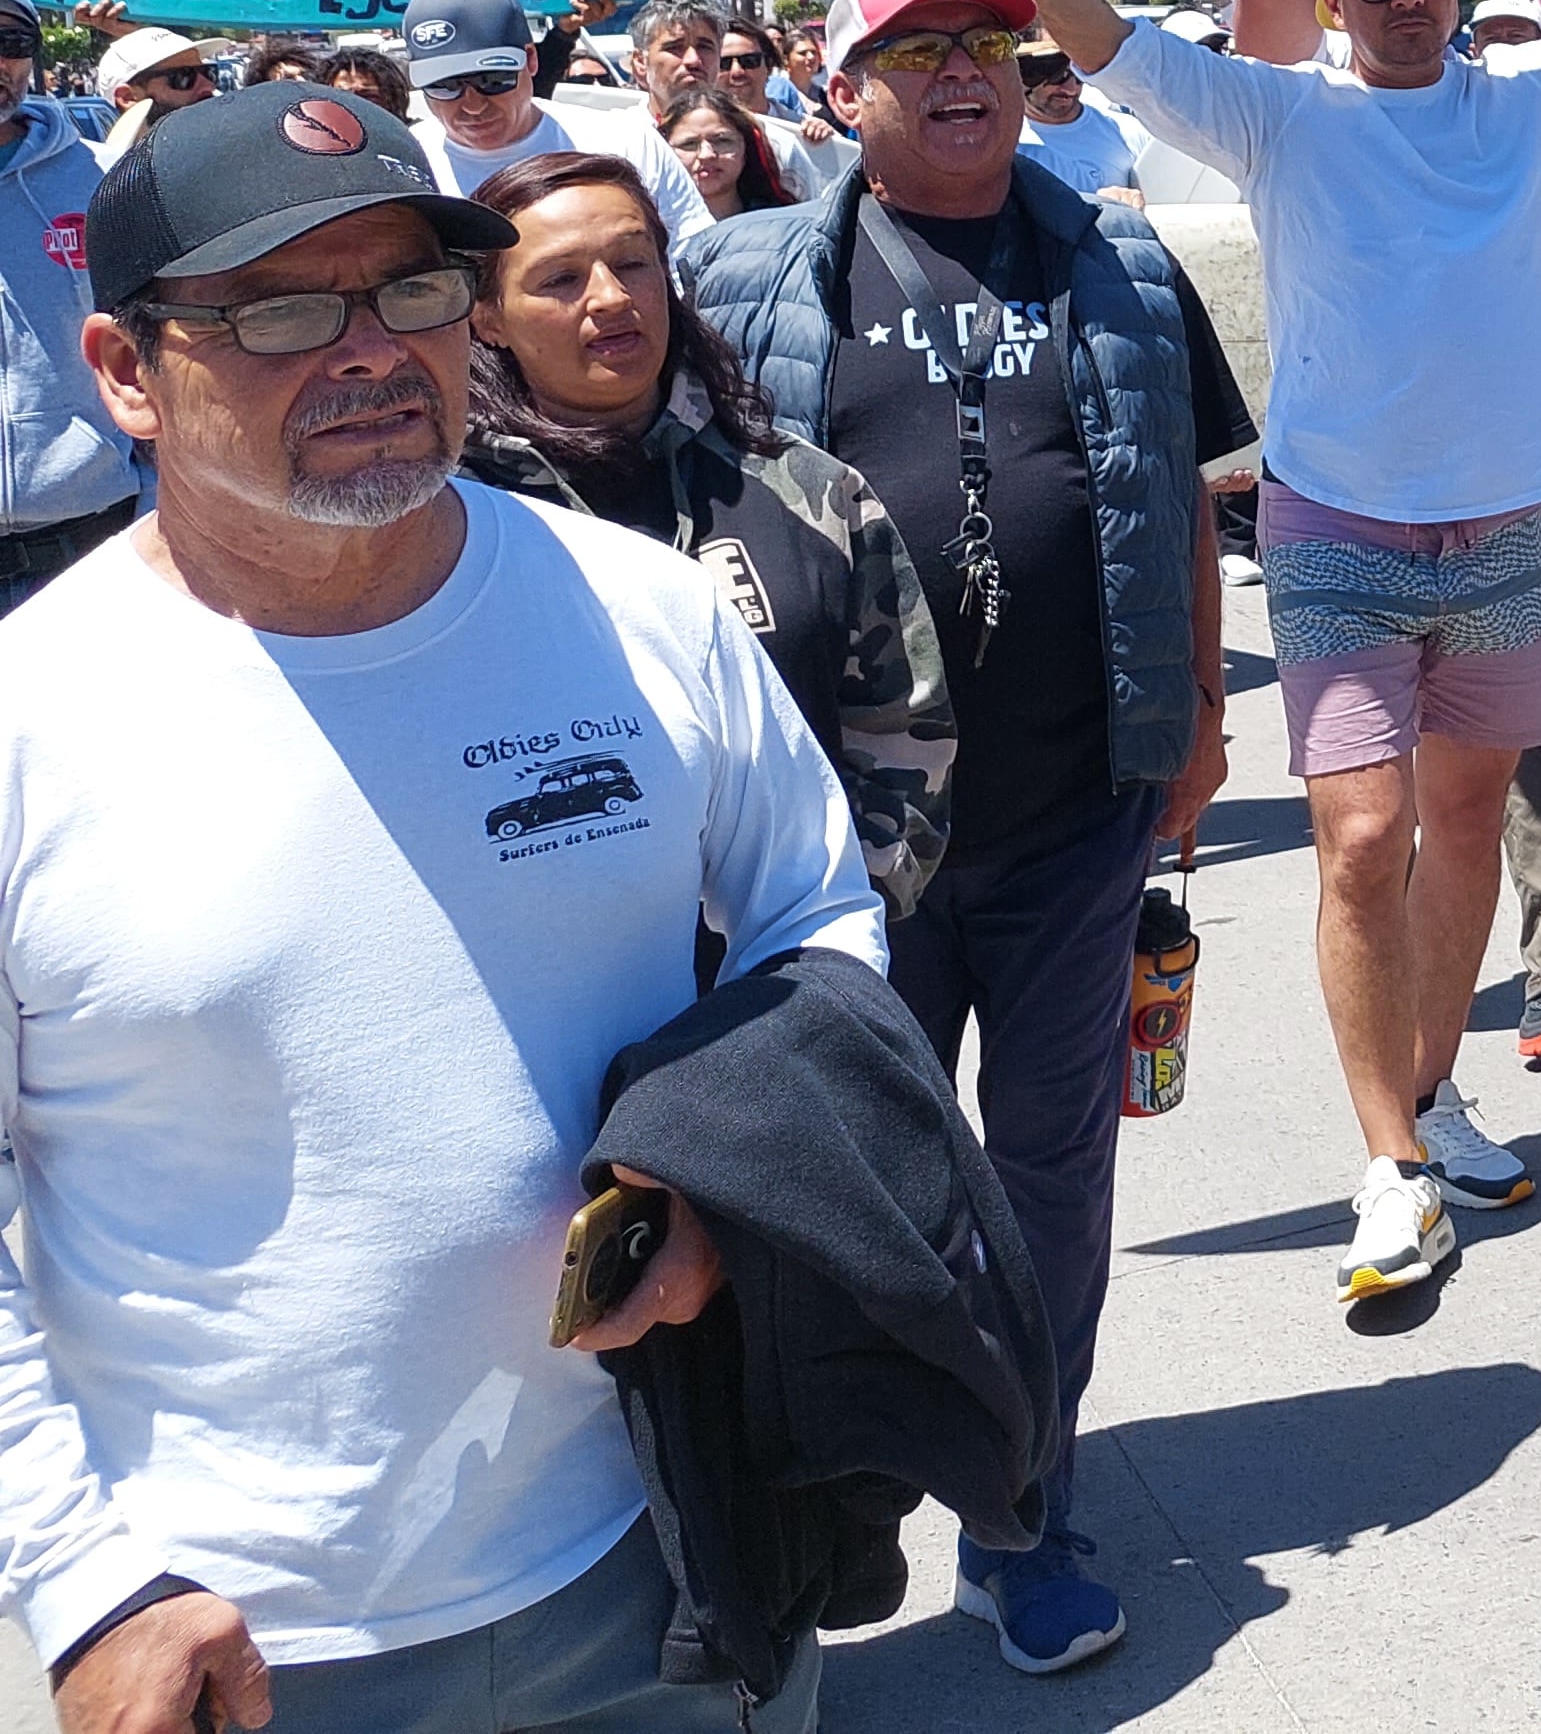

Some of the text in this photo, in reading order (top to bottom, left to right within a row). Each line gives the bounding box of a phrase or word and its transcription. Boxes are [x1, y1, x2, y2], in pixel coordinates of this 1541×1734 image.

[415, 23, 449, 43] SFE
[463, 733, 561, 769] Oldies
[499, 817, 651, 863] Surfers de Ensenada
